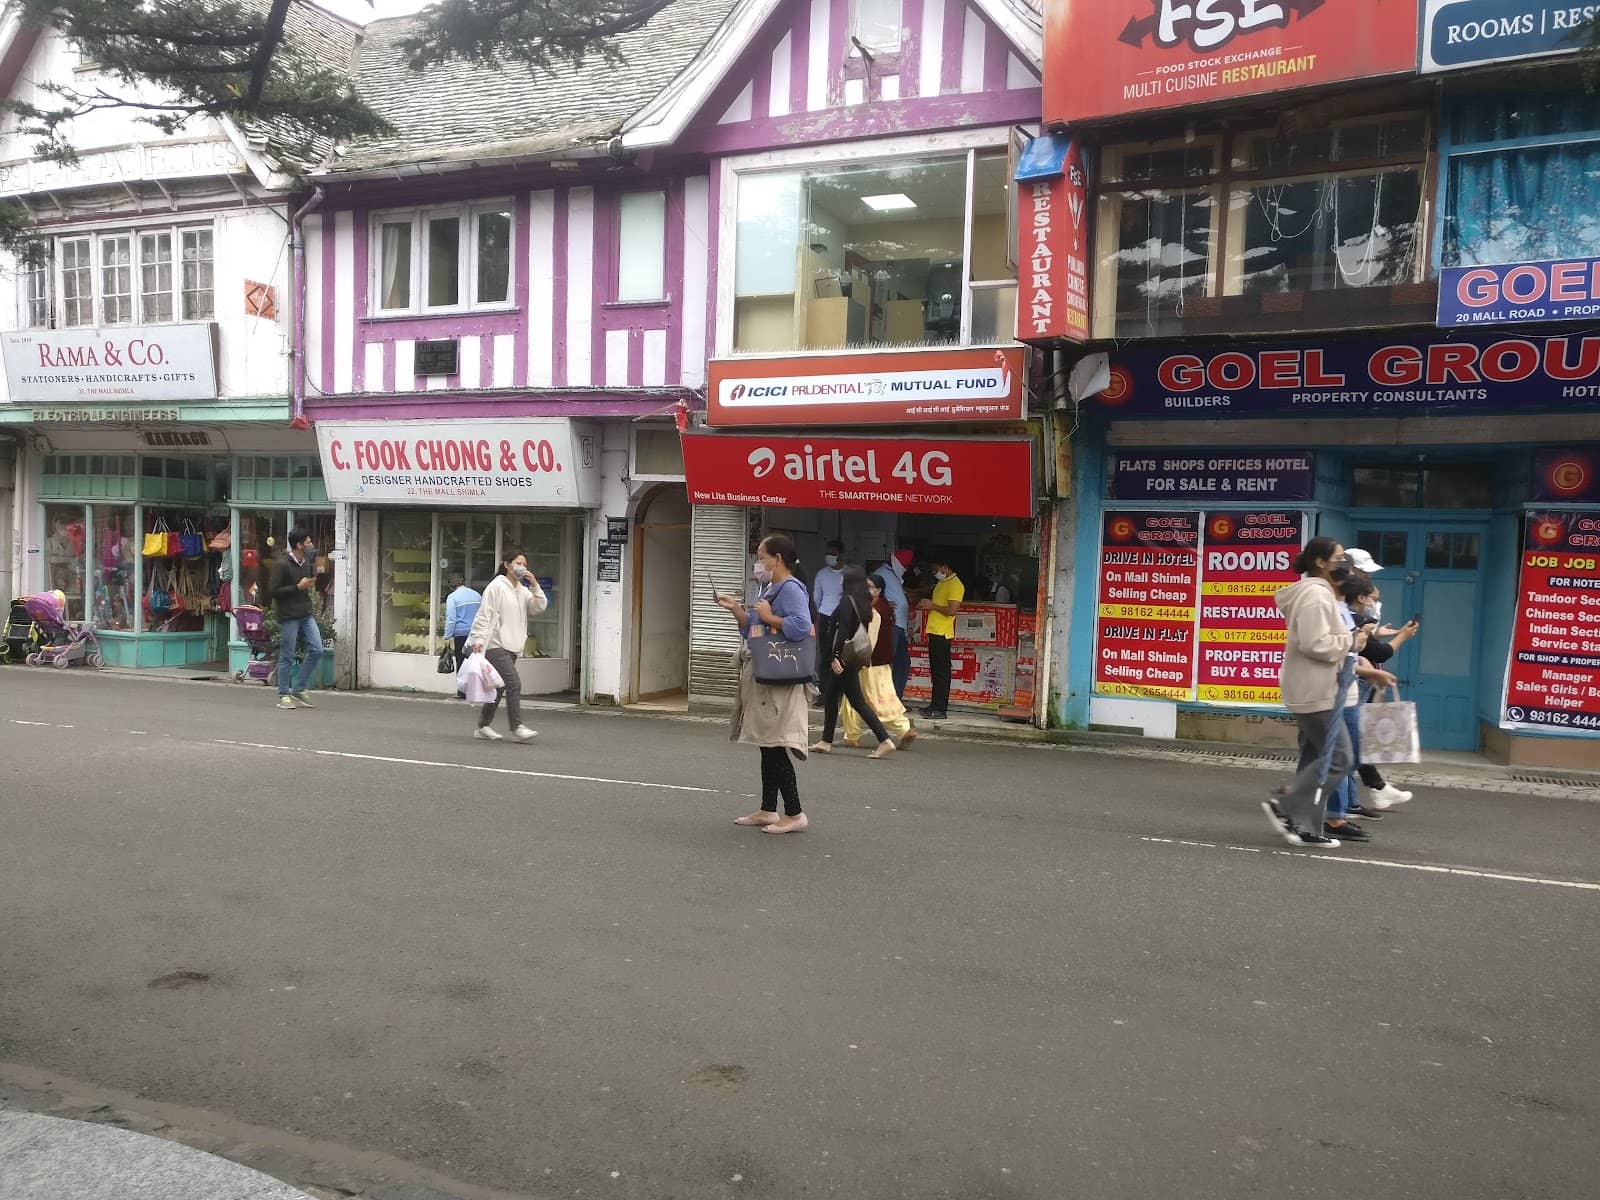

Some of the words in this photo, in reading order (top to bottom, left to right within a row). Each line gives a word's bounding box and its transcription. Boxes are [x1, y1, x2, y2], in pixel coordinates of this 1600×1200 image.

[1446, 14, 1534, 44] ROOMS
[1156, 63, 1185, 75] FOOD
[1187, 57, 1222, 70] STOCK
[1224, 46, 1282, 64] EXCHANGE
[1123, 80, 1162, 100] MULTI
[1165, 71, 1218, 93] CUISINE
[1222, 55, 1316, 84] RESTAURANT
[1031, 182, 1052, 333] RESTAURANT
[1457, 262, 1600, 307] GOE
[1456, 313, 1469, 322] 20
[1472, 311, 1506, 321] MALL
[1509, 308, 1545, 318] ROAD
[38, 343, 100, 367] RAMA
[104, 341, 123, 366] &
[1158, 349, 1345, 391] GOEL
[1368, 337, 1600, 386] GROU
[747, 386, 788, 397] ICICI
[792, 382, 864, 396] PRUDENTIAL
[891, 380, 952, 391] MUTUAL
[956, 378, 997, 389] FUND
[1165, 395, 1230, 407] BUILDERS
[1292, 391, 1369, 403] PROPERTY
[1373, 388, 1487, 402] CONSULTANTS
[331, 440, 350, 470] C.
[354, 440, 411, 471] FOOK
[415, 440, 492, 471] CHONG
[500, 439, 517, 471] &
[523, 440, 562, 472] CO.
[783, 444, 880, 483] airtel
[892, 450, 953, 485] 4G
[1119, 460, 1156, 471] FLATS
[1163, 460, 1205, 471] SHOPS
[1208, 459, 1262, 471] OFFICES
[1265, 459, 1309, 470] HOTEL
[361, 475, 412, 486] DESIGNER
[414, 475, 493, 487] HANDCRAFTED
[495, 477, 532, 487] SHOES
[1146, 478, 1175, 491] FOR
[1179, 478, 1217, 491] SALE
[1220, 478, 1232, 491] &
[1237, 478, 1278, 491] RENT
[419, 488, 434, 496] THE
[434, 488, 456, 496] MALL
[457, 488, 486, 497] SHIMLA
[694, 491, 710, 499] New
[711, 492, 726, 500] Lite
[727, 493, 761, 502] Business
[761, 494, 786, 504] Center
[819, 490, 837, 498] THE
[838, 491, 903, 501] SMARTPHONE
[905, 494, 953, 503] NETWORK
[1145, 518, 1192, 528] GOEL
[1244, 514, 1290, 524] GOEL
[1114, 521, 1129, 536] G
[1214, 519, 1229, 534] G
[1238, 528, 1297, 538] GROUP
[1539, 522, 1557, 539] G
[1138, 530, 1197, 541] GROUP
[1568, 534, 1600, 546] GR
[1103, 552, 1138, 565] DRIVE
[1140, 552, 1154, 565] IN
[1156, 553, 1196, 567] HOTEL
[1208, 551, 1290, 571] ROOMS
[1526, 556, 1558, 568] JOB
[1564, 558, 1596, 570] JOB
[1106, 571, 1121, 582] On
[1124, 571, 1148, 583] Mall
[1151, 572, 1191, 584] Shimla
[1549, 577, 1570, 586] FOR
[1108, 587, 1147, 601] Selling
[1150, 589, 1187, 603] Cheap
[1227, 585, 1256, 593] 98162
[1527, 591, 1577, 604] Tandoor
[1120, 607, 1153, 616] 98162
[1156, 608, 1190, 618] 44444
[1526, 608, 1574, 620] Chinese
[1104, 626, 1139, 639] DRIVE
[1142, 627, 1155, 640] IN
[1158, 628, 1188, 642] FLAT
[1529, 623, 1567, 635] Indian
[1224, 632, 1247, 640] 0177
[1531, 637, 1578, 650] Service
[1102, 648, 1117, 659] On
[1121, 649, 1144, 660] Mall
[1148, 650, 1188, 663] Shimla
[1518, 652, 1535, 660] FOR
[1537, 654, 1560, 662] SHOP
[1104, 665, 1142, 680] Selling
[1146, 667, 1183, 682] Cheap
[1211, 666, 1237, 677] BUY
[1240, 667, 1250, 678] &
[1542, 669, 1593, 683] Manager
[1115, 686, 1139, 695] 0177
[1143, 688, 1186, 698] 2654444
[1515, 681, 1547, 692] Sales
[1551, 684, 1578, 695] Girls
[1224, 690, 1255, 699] 98160
[1258, 691, 1282, 701] 444
[1545, 695, 1584, 708] Helper
[1529, 710, 1569, 724] 98162
